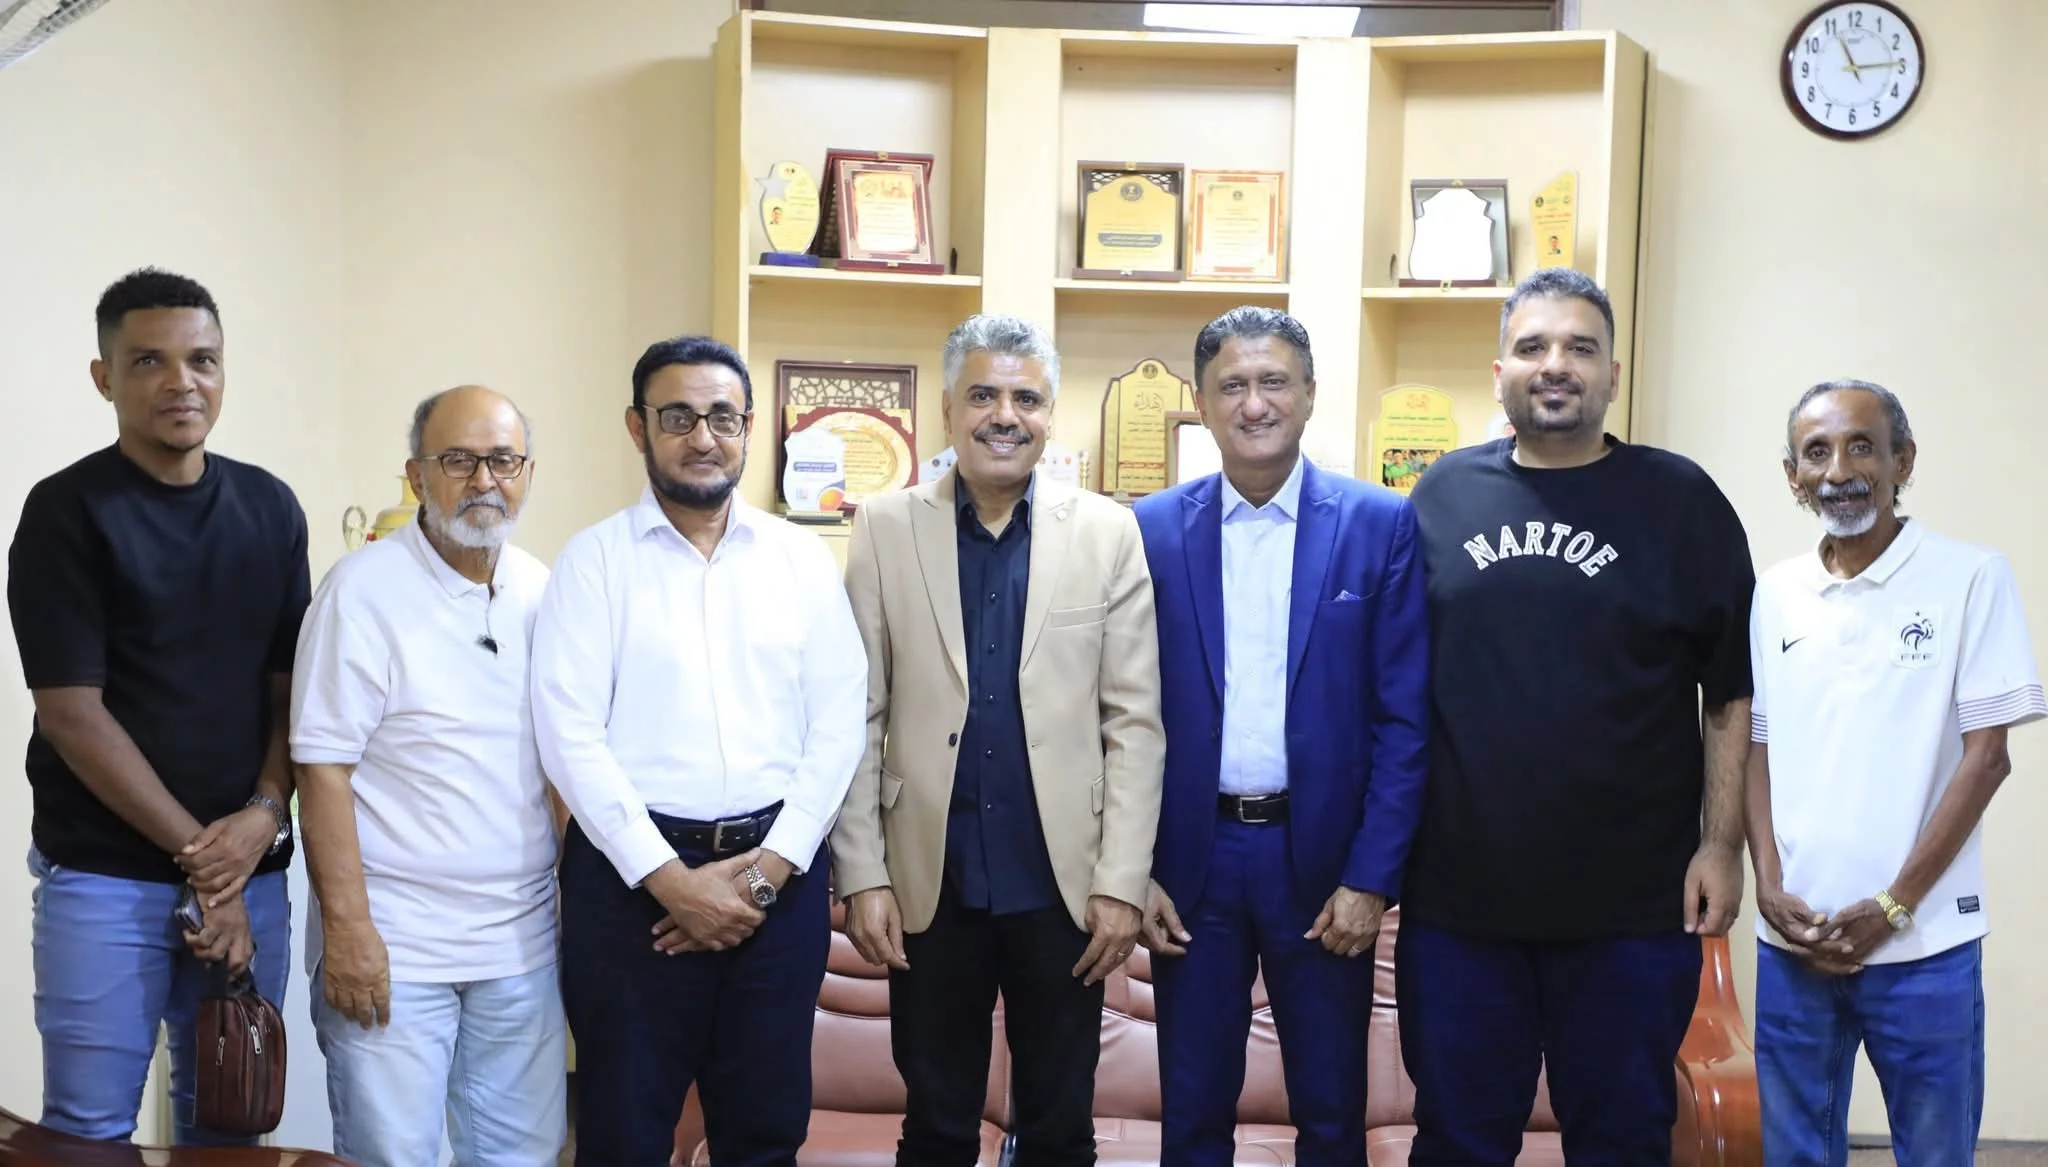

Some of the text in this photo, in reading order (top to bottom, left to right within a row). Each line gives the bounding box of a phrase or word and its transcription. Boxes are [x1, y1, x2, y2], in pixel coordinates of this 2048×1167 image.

[1825, 18, 1837, 36] 11
[1848, 10, 1863, 28] 12
[1876, 16, 1882, 33] 1
[1805, 37, 1820, 54] 10
[1892, 34, 1900, 51] 2
[1802, 62, 1809, 78] 9
[1898, 58, 1906, 75] 3
[1807, 86, 1815, 103] 8
[1890, 82, 1899, 98] 4
[1825, 103, 1833, 120] 7
[1849, 109, 1857, 125] 6
[1873, 101, 1881, 118] 5
[1463, 521, 1619, 578] NARTOE
